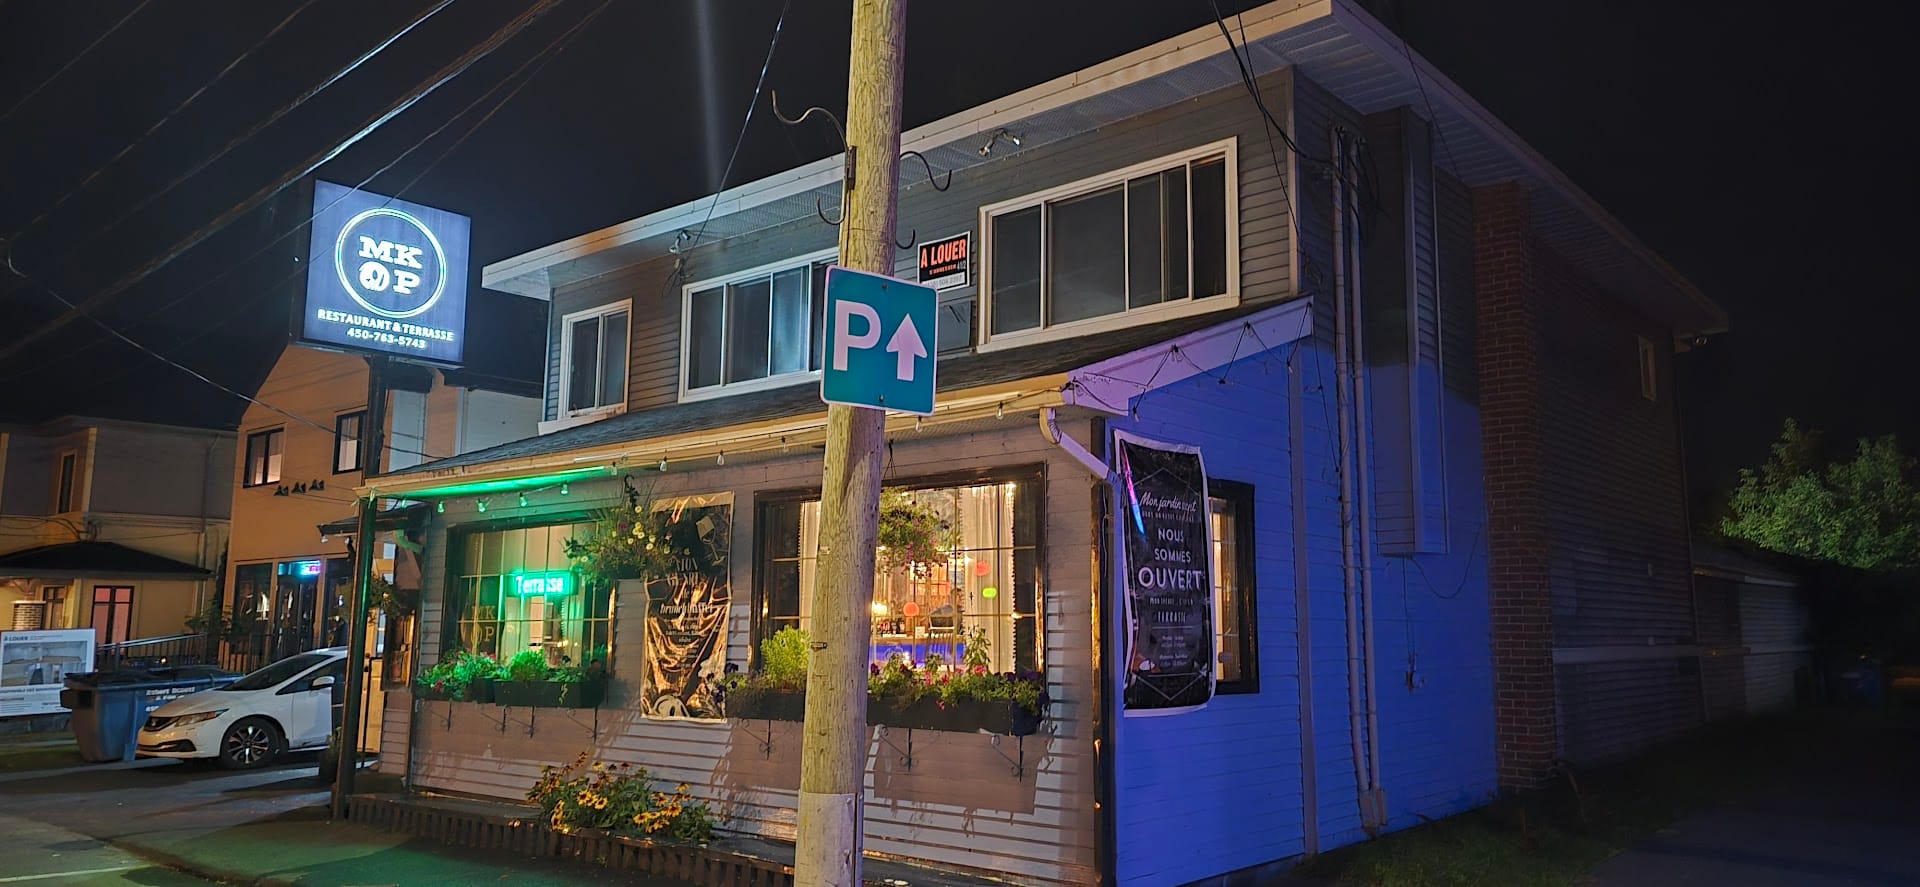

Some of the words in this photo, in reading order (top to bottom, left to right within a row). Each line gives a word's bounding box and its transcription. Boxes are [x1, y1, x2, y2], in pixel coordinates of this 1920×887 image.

[358, 235, 424, 269] MK
[920, 247, 928, 269] A
[930, 239, 966, 266] LOUER
[317, 308, 393, 331] RESTAURANT
[401, 323, 455, 342] TERRASSE
[832, 299, 882, 371] P
[346, 327, 426, 349] 450-763-5743
[1157, 527, 1184, 543] NOUS
[1154, 547, 1192, 564] SOMMES
[515, 575, 564, 594] Terrasse
[1137, 566, 1202, 591] OUVERT
